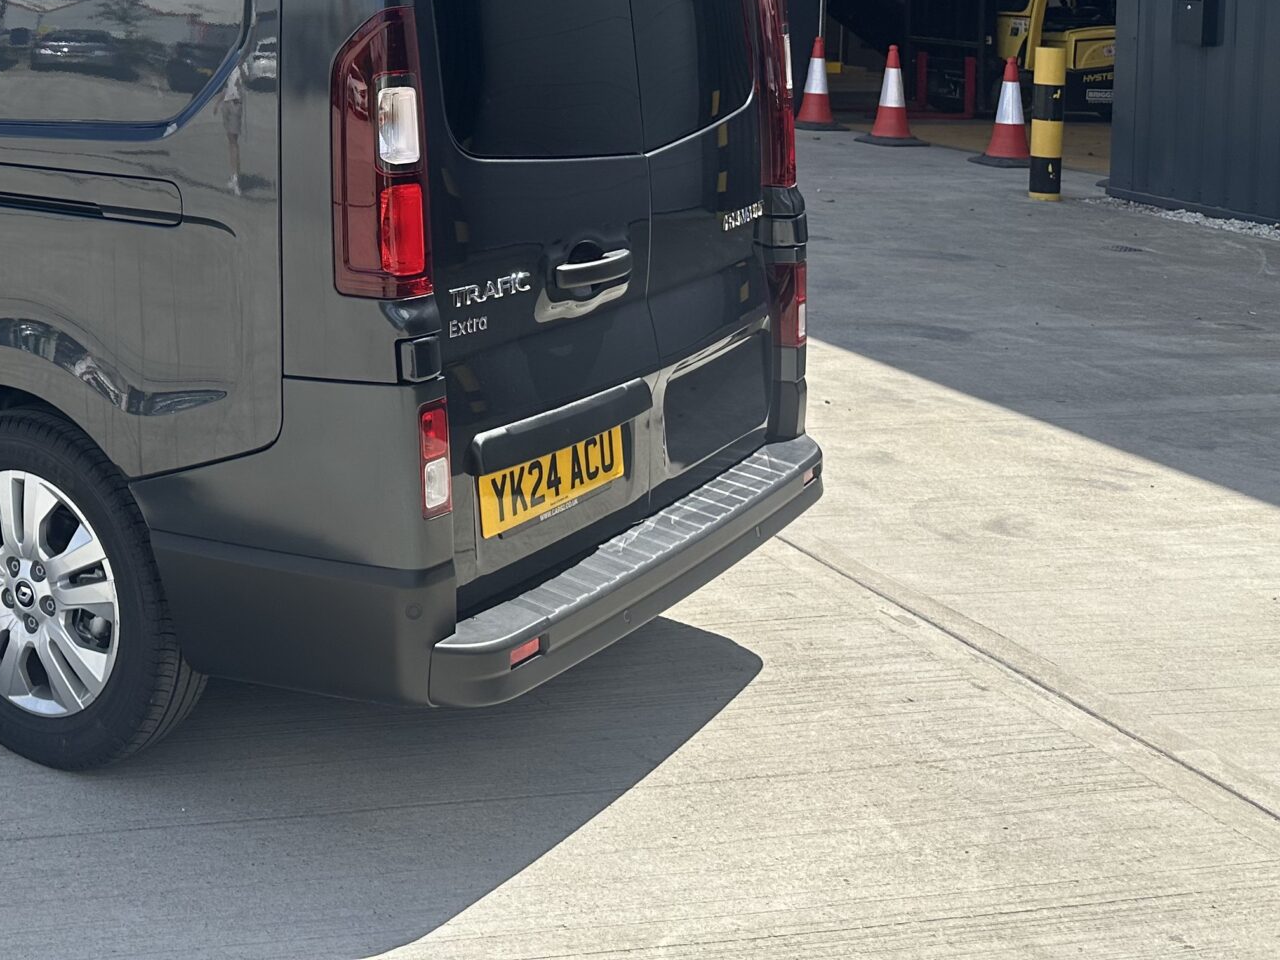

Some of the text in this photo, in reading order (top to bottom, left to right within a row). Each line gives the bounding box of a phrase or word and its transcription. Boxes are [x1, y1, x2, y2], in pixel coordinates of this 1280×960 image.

[1083, 72, 1114, 82] HYSTE
[448, 271, 531, 308] TRAFIC
[449, 315, 488, 338] Extra
[491, 429, 615, 522] YK24 ACU
